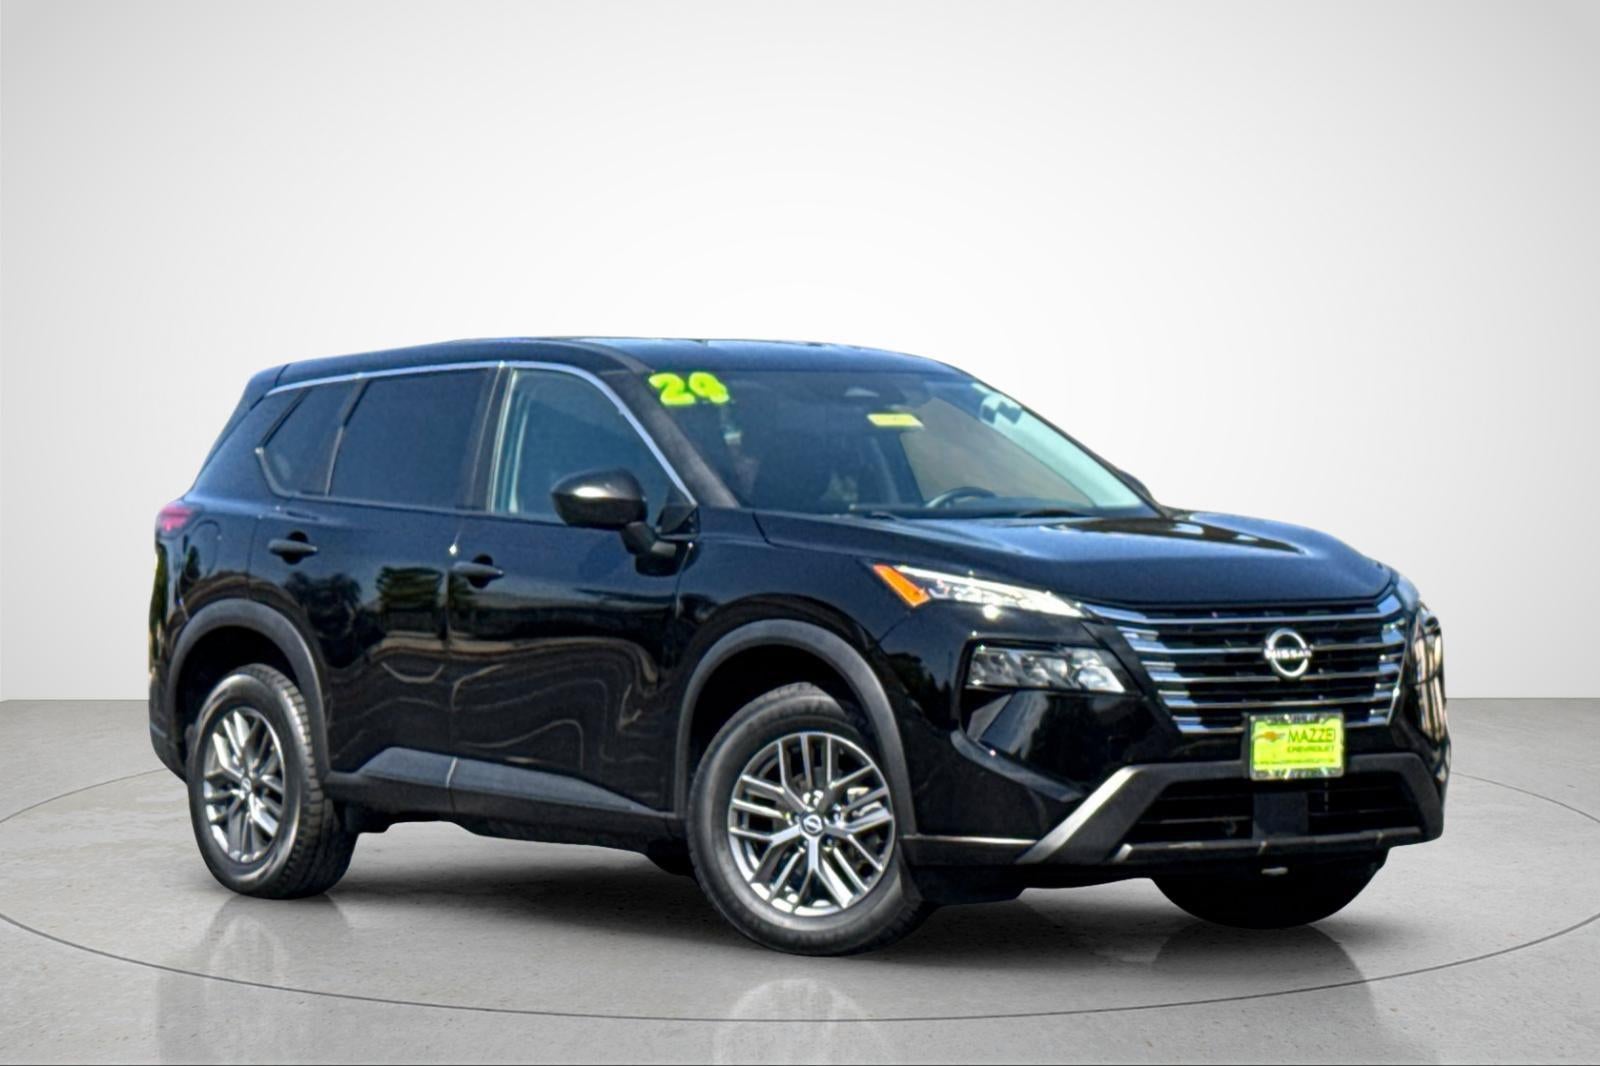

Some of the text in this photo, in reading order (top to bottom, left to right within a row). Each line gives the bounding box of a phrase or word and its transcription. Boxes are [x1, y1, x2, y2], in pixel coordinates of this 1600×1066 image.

[648, 371, 730, 406] 24
[1263, 647, 1312, 659] NISSAN
[1287, 727, 1336, 743] MAZZEI
